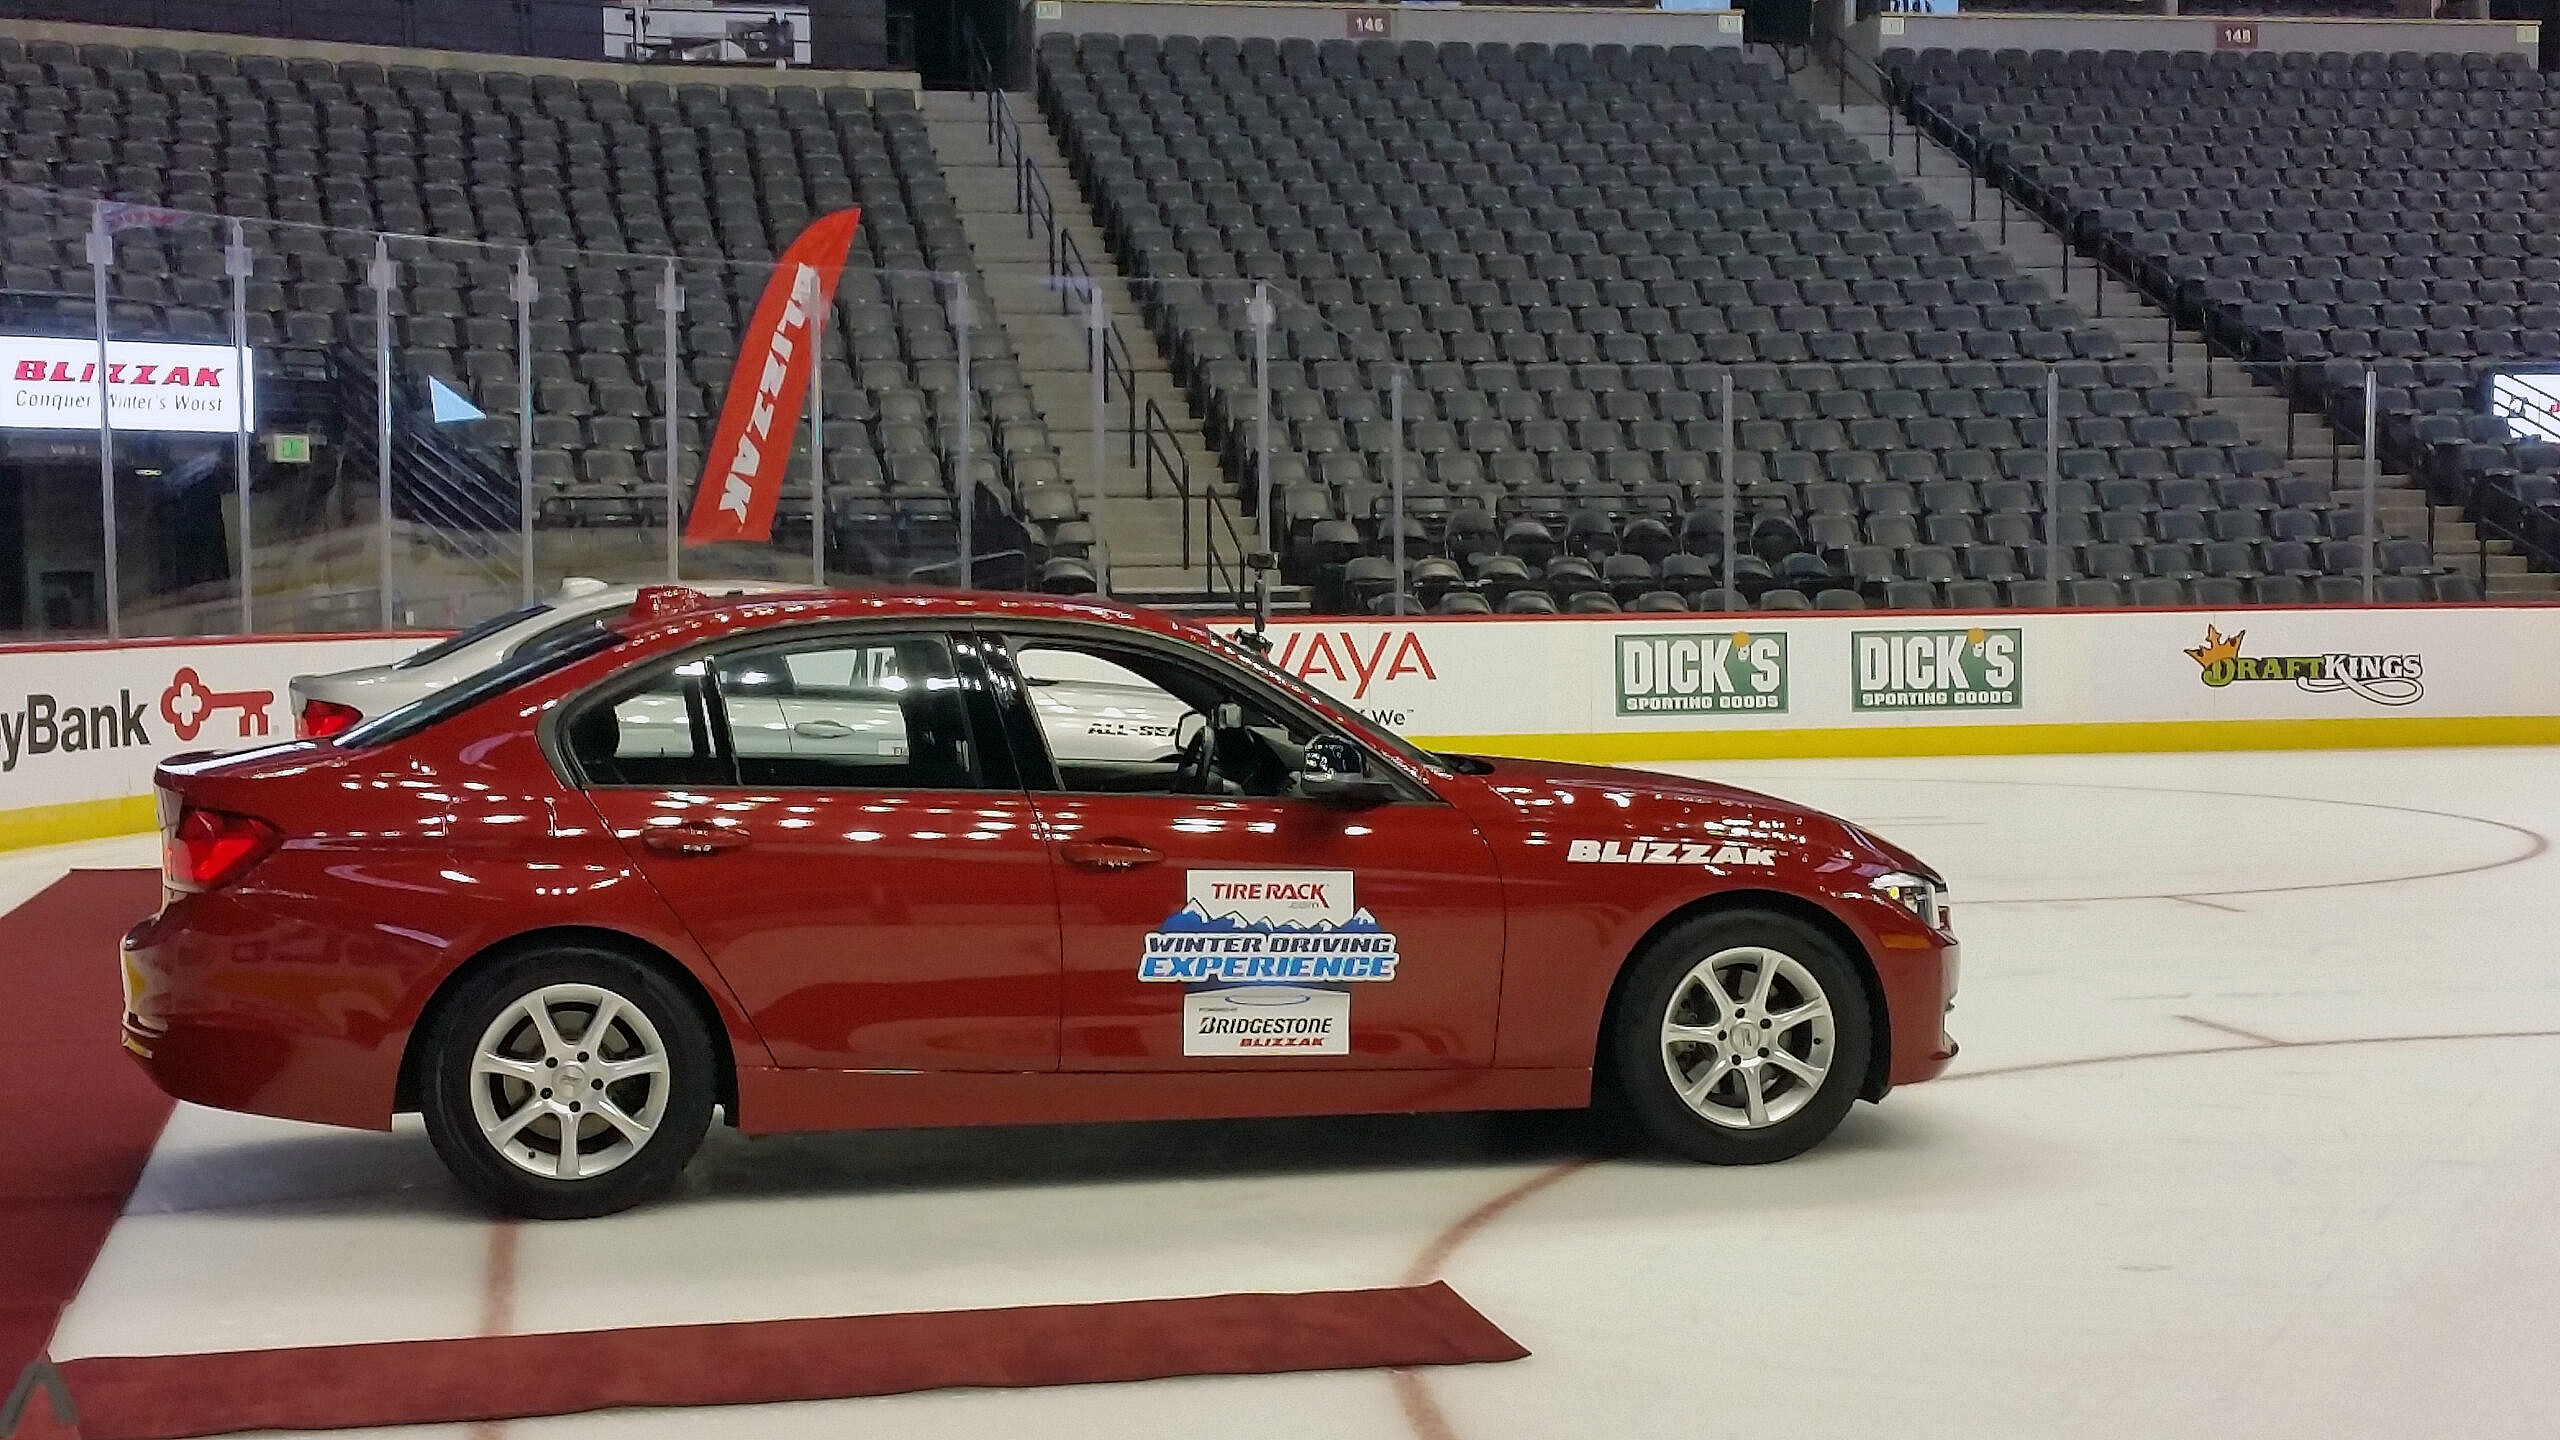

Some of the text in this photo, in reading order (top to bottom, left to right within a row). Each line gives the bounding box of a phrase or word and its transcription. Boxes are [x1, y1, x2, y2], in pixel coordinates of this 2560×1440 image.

[1356, 17, 1384, 32] 146
[15, 360, 224, 386] BLIZZAK
[16, 390, 91, 411] Conquer
[175, 395, 222, 411] Worst
[719, 261, 821, 526] BLIZZAK
[1224, 631, 1437, 700] VAYA
[1623, 636, 1781, 695] DICK'S
[1859, 634, 2015, 692] DICK'S
[1626, 695, 1778, 710] SPORTING GOODS
[1862, 691, 2012, 706] SPORTING GOODS
[1567, 840, 1777, 866] BLIZZAK
[1211, 883, 1330, 909] TIRE RACK
[1149, 936, 1392, 953] WINTER DRIVING
[1143, 956, 1396, 977] EXPERIENCE
[1198, 1016, 1333, 1034] BRIDGESTONE
[1240, 1037, 1324, 1047] BLIZZAK
